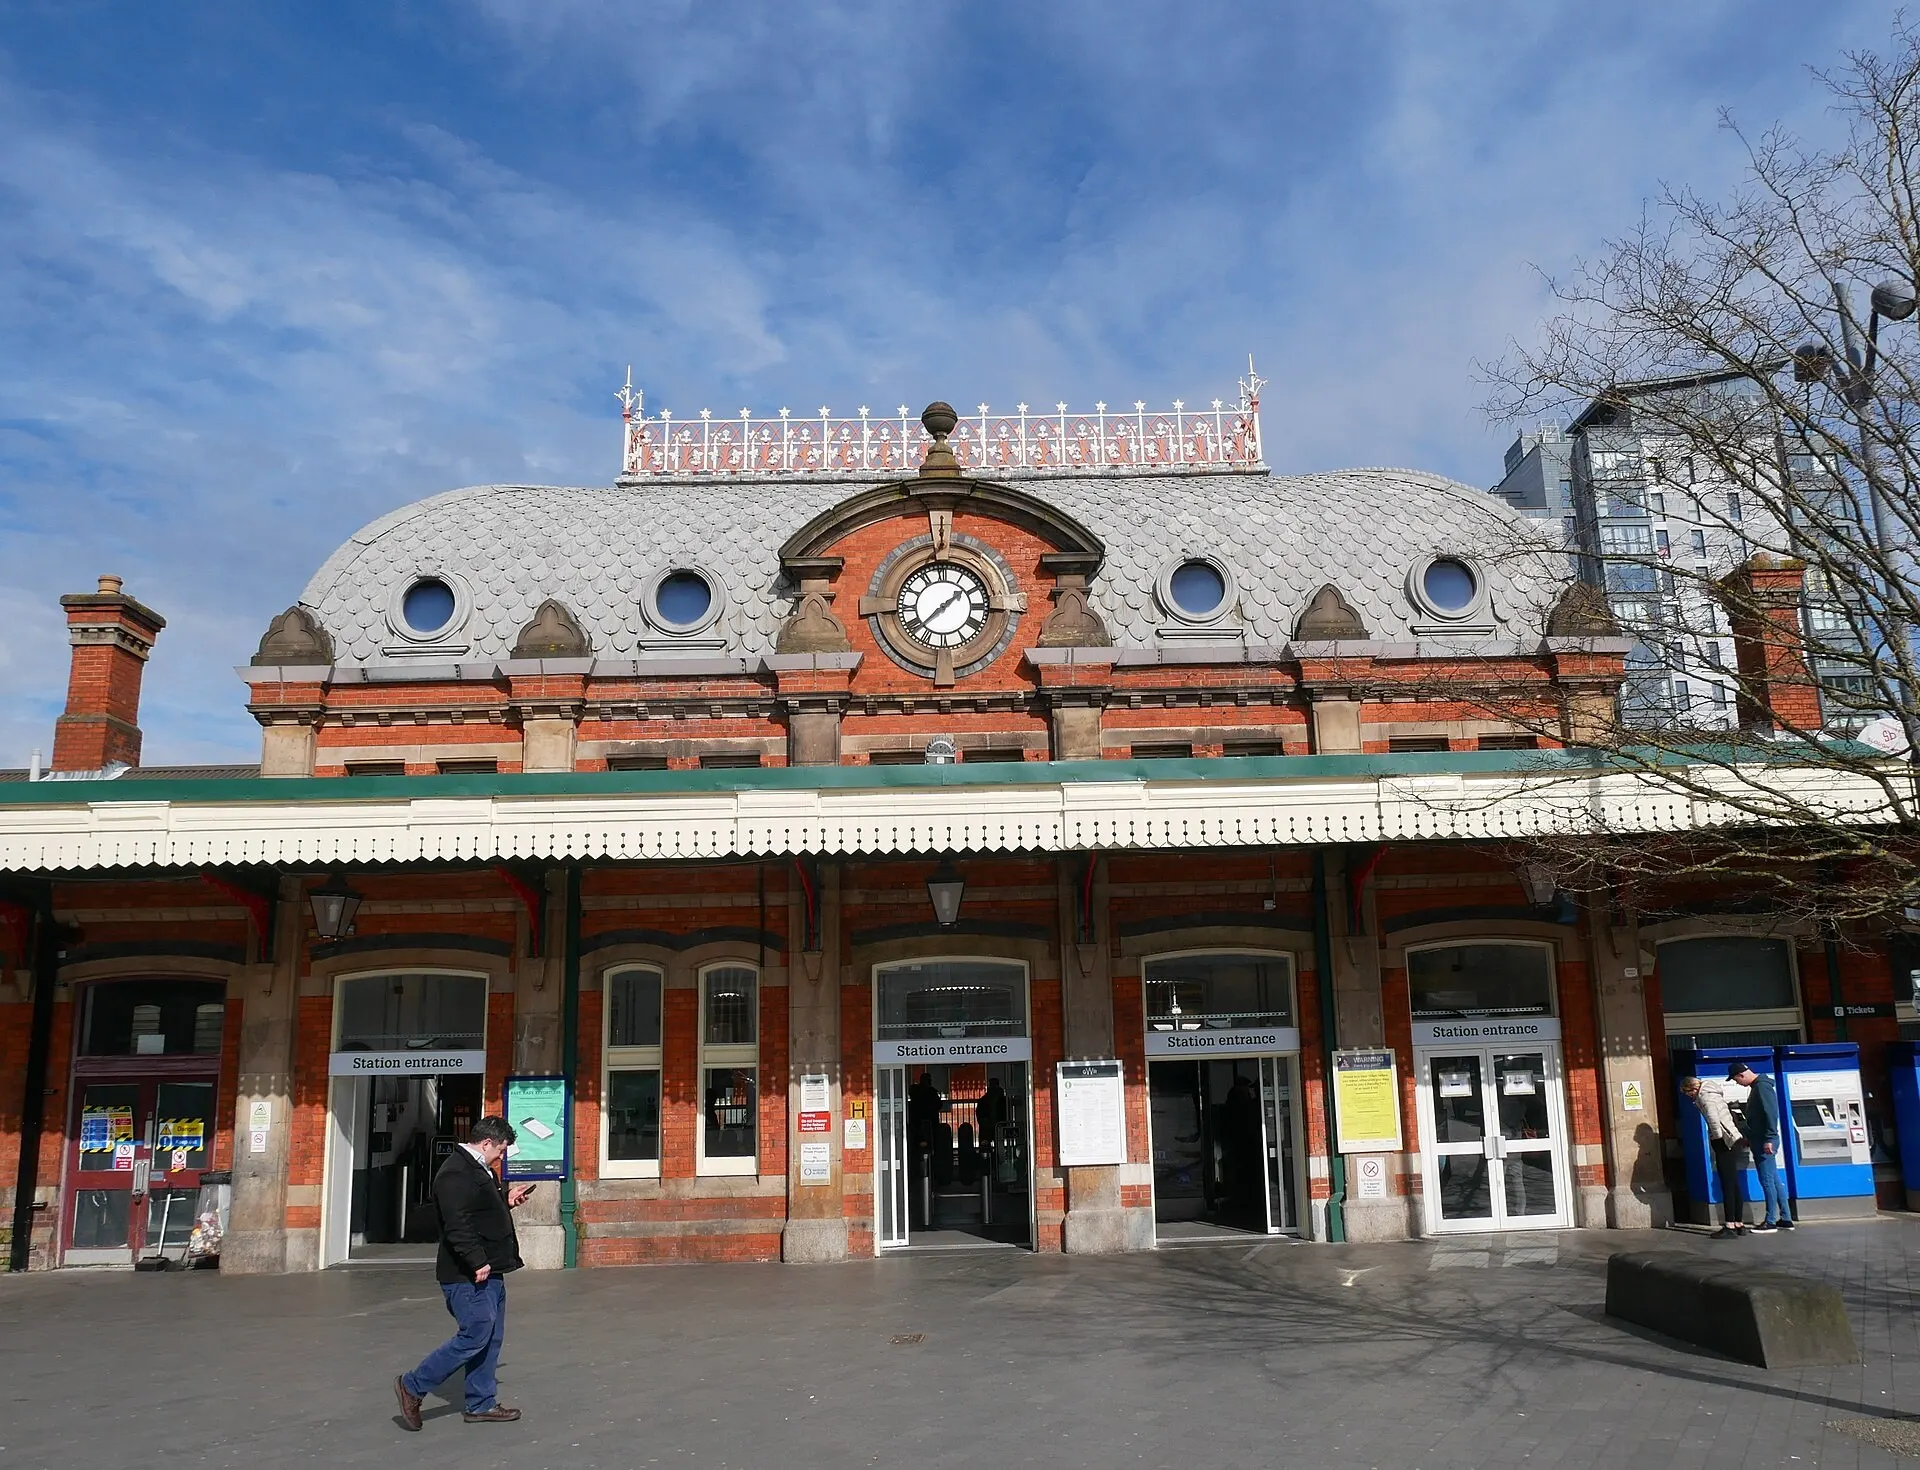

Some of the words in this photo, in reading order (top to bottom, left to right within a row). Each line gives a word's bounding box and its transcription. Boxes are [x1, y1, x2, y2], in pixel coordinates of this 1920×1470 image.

[1846, 1006, 1875, 1014] Tickets
[1433, 1025, 1479, 1038] Station
[1482, 1024, 1538, 1036] entrance
[1167, 1036, 1215, 1048] Station
[1218, 1034, 1276, 1046] entrance
[897, 1045, 945, 1057] Station
[949, 1043, 1008, 1056] entrance
[353, 1057, 401, 1069] Station
[404, 1056, 463, 1068] entrance
[1082, 1067, 1098, 1076] GWR
[852, 1102, 865, 1118] H
